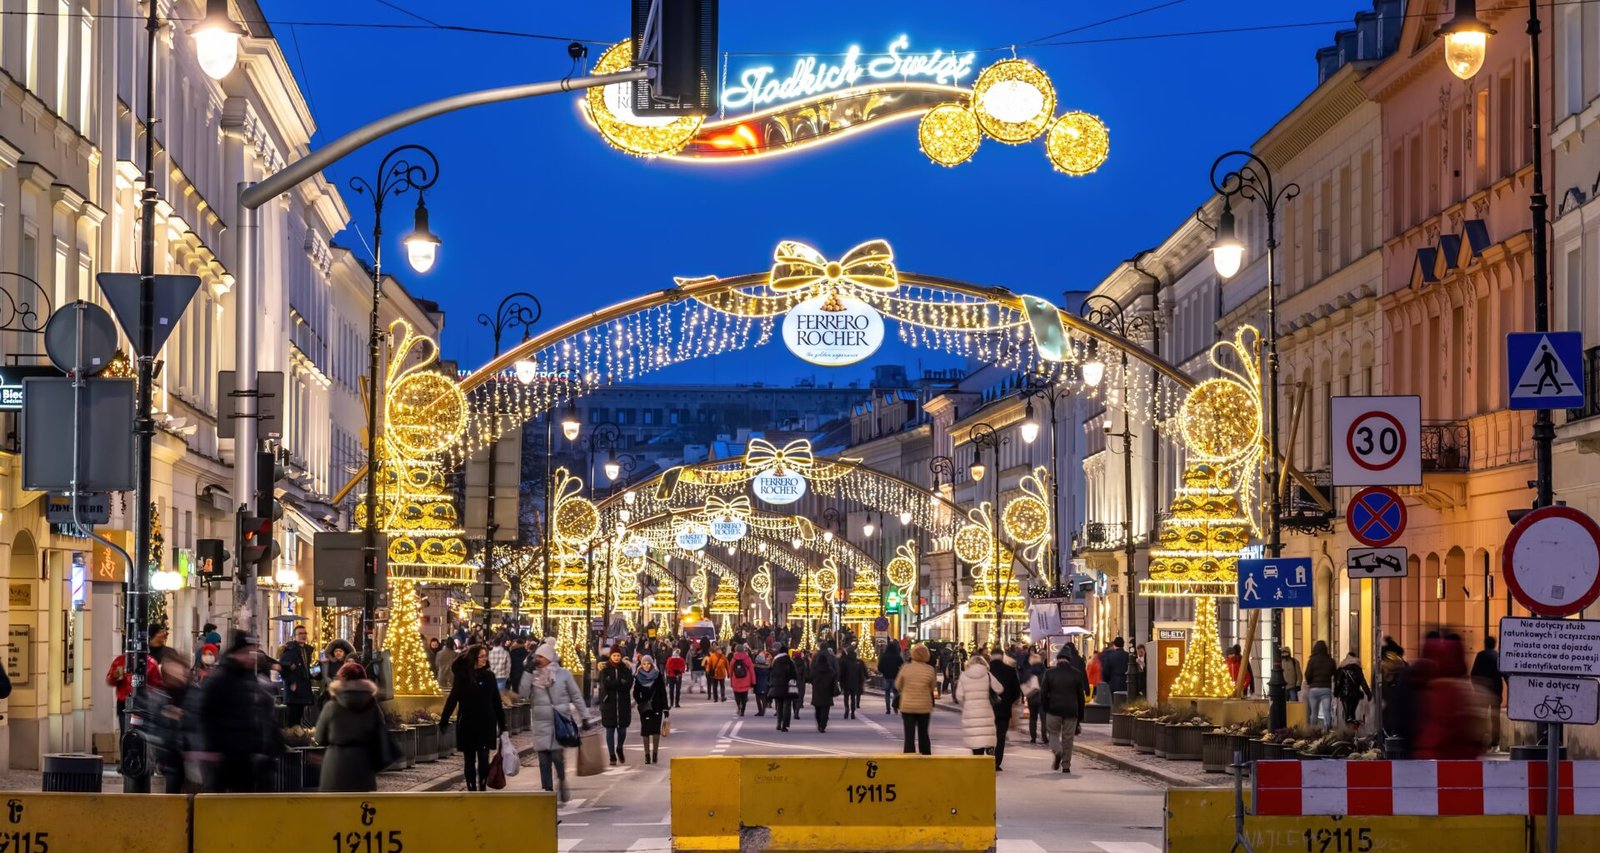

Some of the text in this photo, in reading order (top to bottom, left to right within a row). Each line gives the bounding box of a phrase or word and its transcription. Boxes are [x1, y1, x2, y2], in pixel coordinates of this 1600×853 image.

[797, 314, 869, 330] FERRERO
[797, 330, 869, 346] ROCHER
[1355, 426, 1398, 456] 30
[760, 477, 799, 486] FERRERO
[760, 486, 799, 495] ROCHER
[1520, 620, 1533, 629] Nie
[1535, 621, 1564, 631] dotyczy
[1160, 630, 1185, 638] BILETY
[1503, 630, 1553, 640] ratunkowych
[1513, 641, 1541, 649] miasta
[1561, 643, 1593, 652] dojazdu
[1505, 650, 1599, 663] mieszkańców do posesji
[1520, 660, 1582, 672] identyfikatorem
[1583, 664, 1593, 672] TK
[1528, 679, 1580, 691] Nie dotyczy
[847, 784, 897, 803] 19115
[333, 830, 403, 853] 19115
[1304, 827, 1373, 853] 19115
